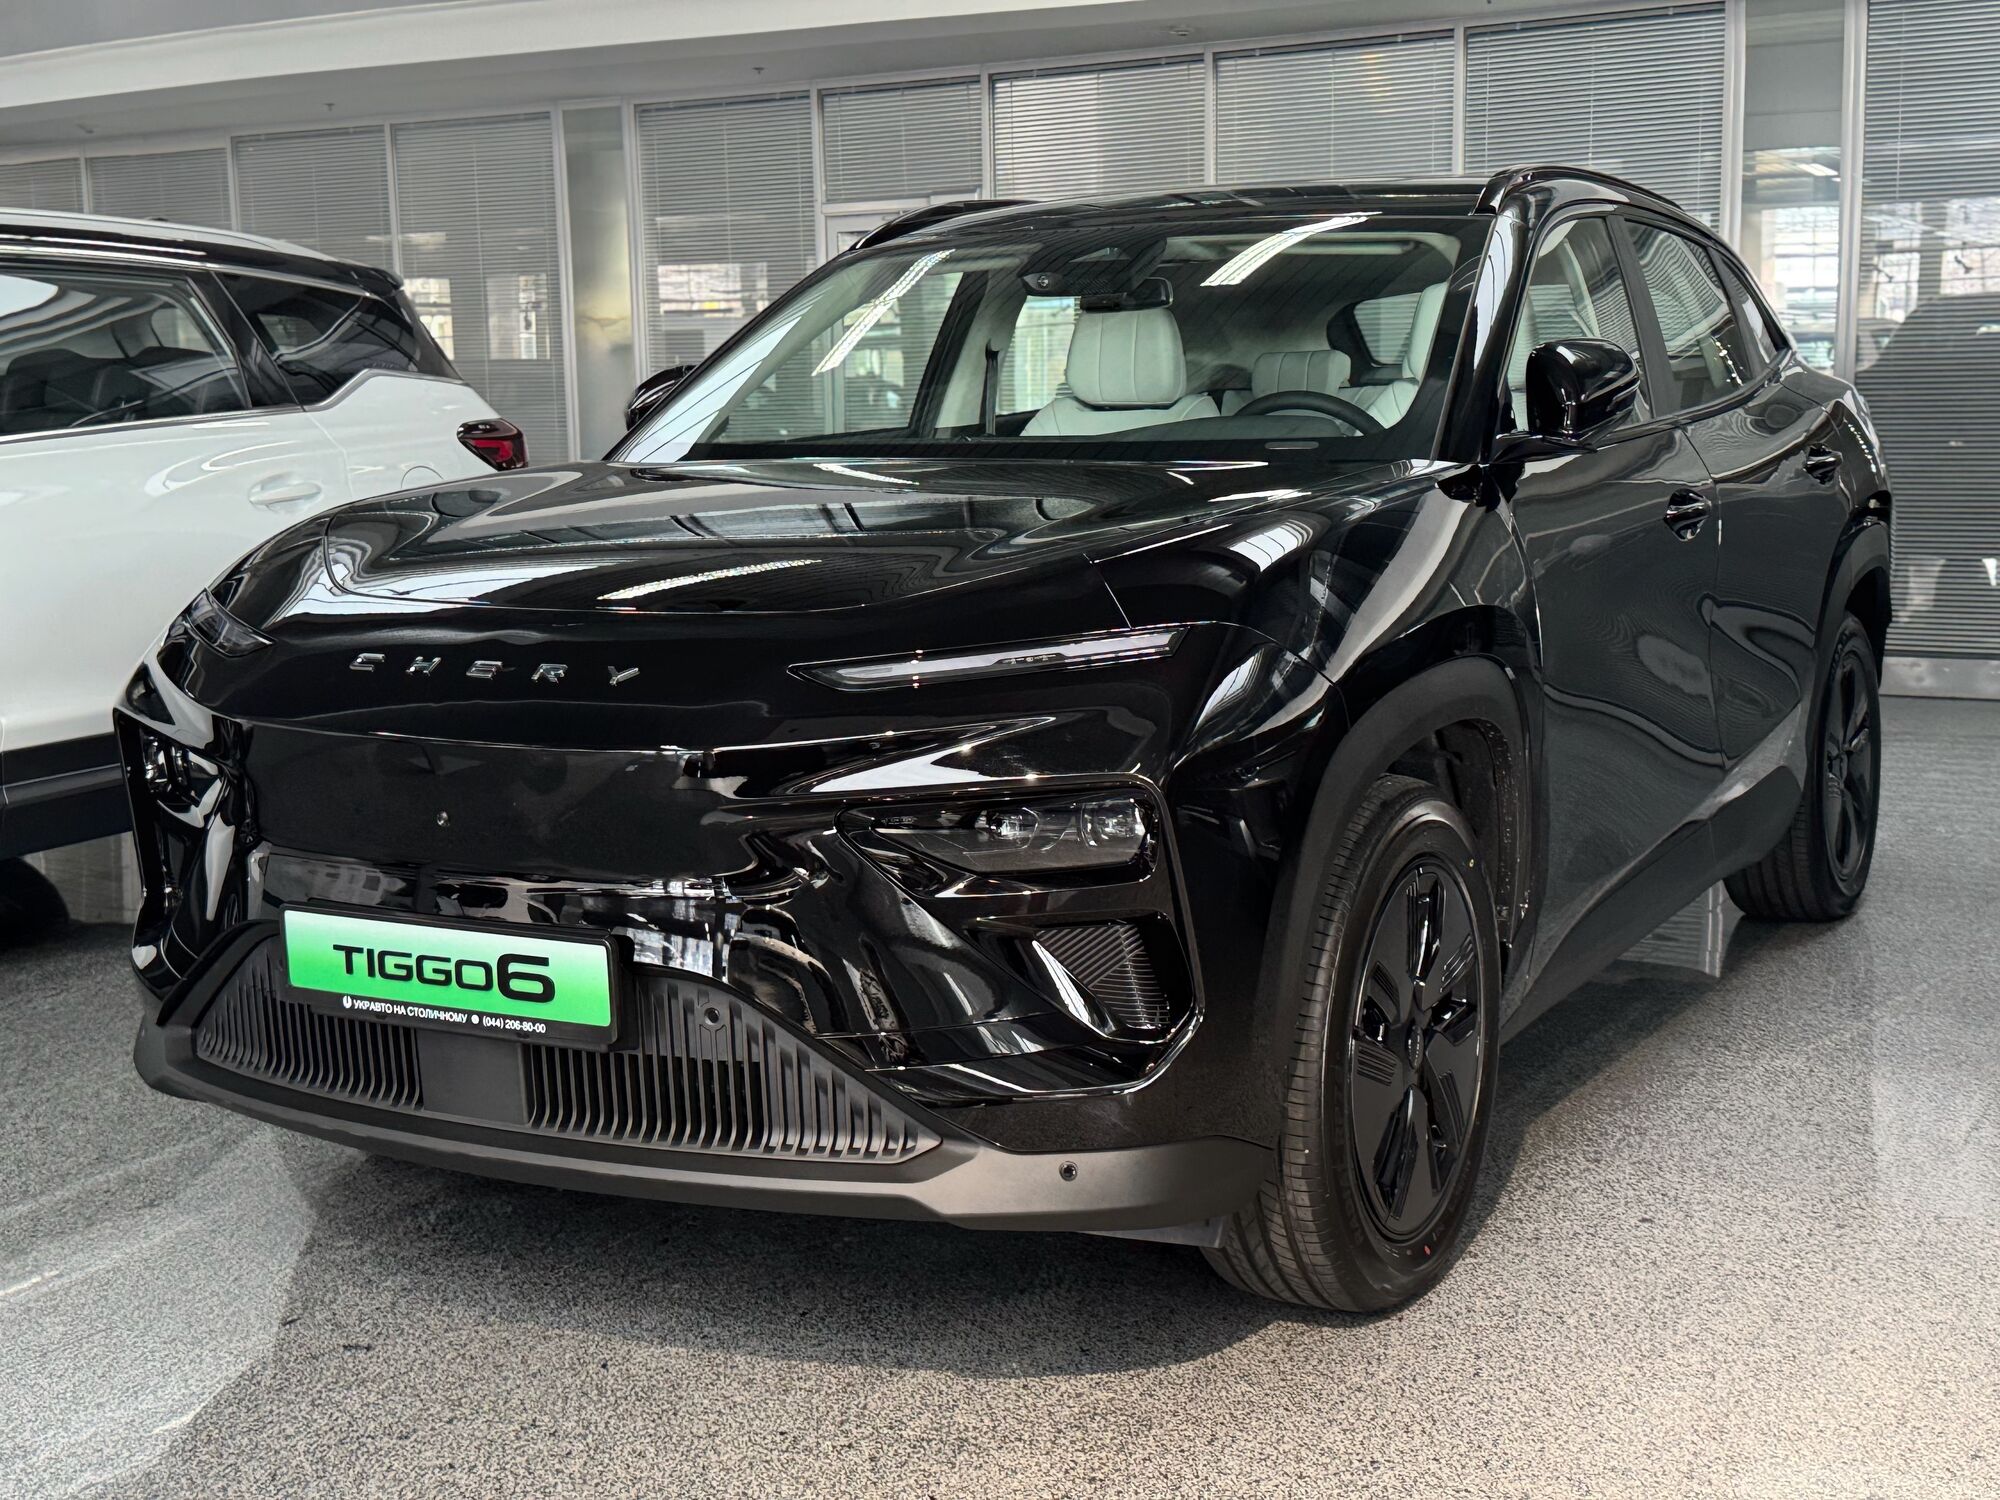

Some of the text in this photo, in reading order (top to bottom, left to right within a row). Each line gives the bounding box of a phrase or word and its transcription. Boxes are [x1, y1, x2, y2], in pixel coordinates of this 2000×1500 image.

[349, 652, 641, 686] CHERY
[353, 999, 546, 1034] УКРАВТО НА СТОЛИЧНОМУ (044) 206-80-00
